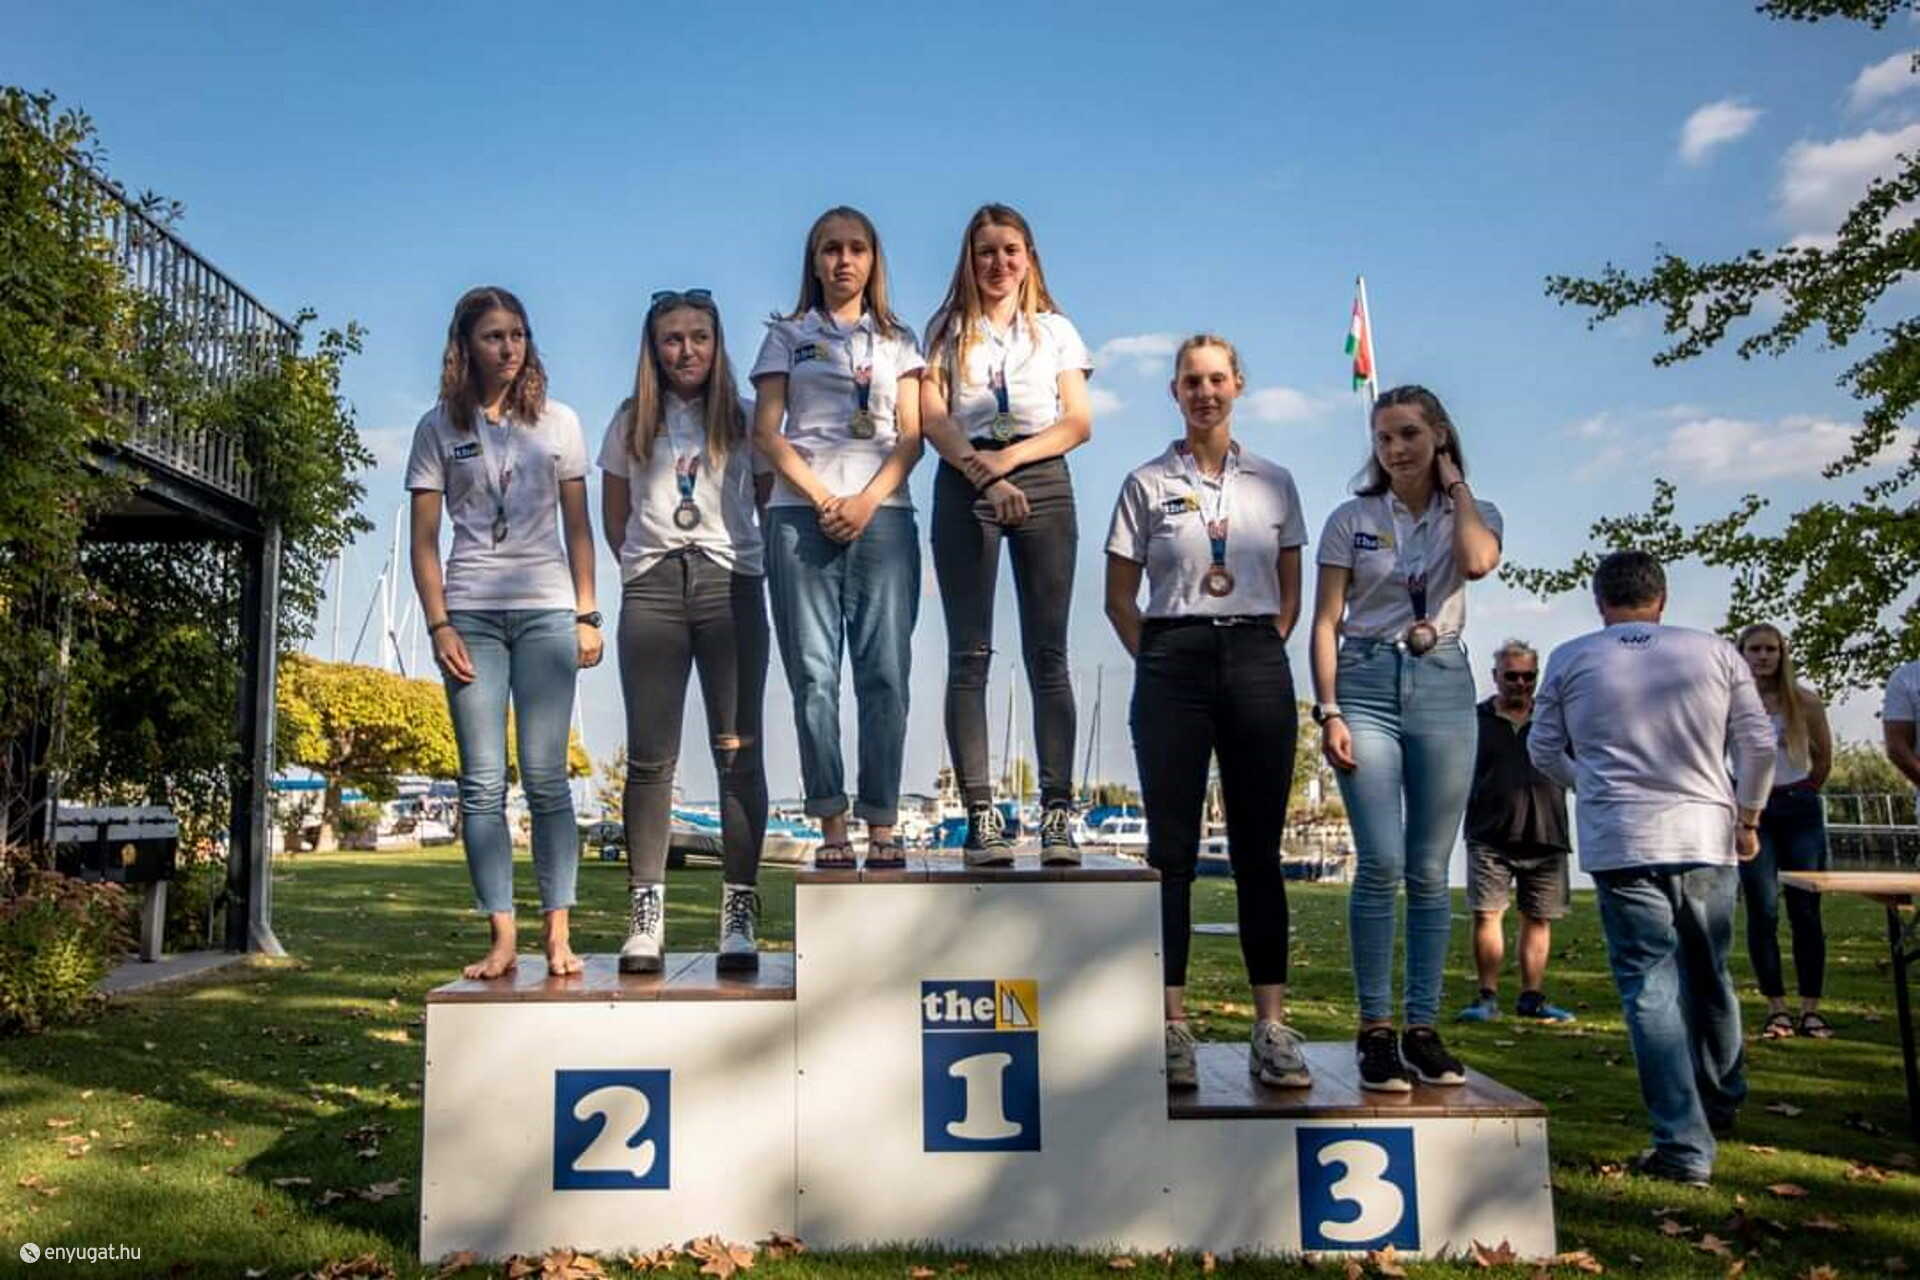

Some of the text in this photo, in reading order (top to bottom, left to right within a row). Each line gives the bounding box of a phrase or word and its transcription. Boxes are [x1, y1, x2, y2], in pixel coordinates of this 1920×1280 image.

[1355, 535, 1378, 548] the
[923, 989, 995, 1022] the
[572, 1085, 656, 1177] 2
[946, 1052, 1023, 1140] 1
[1317, 1139, 1404, 1242] 3
